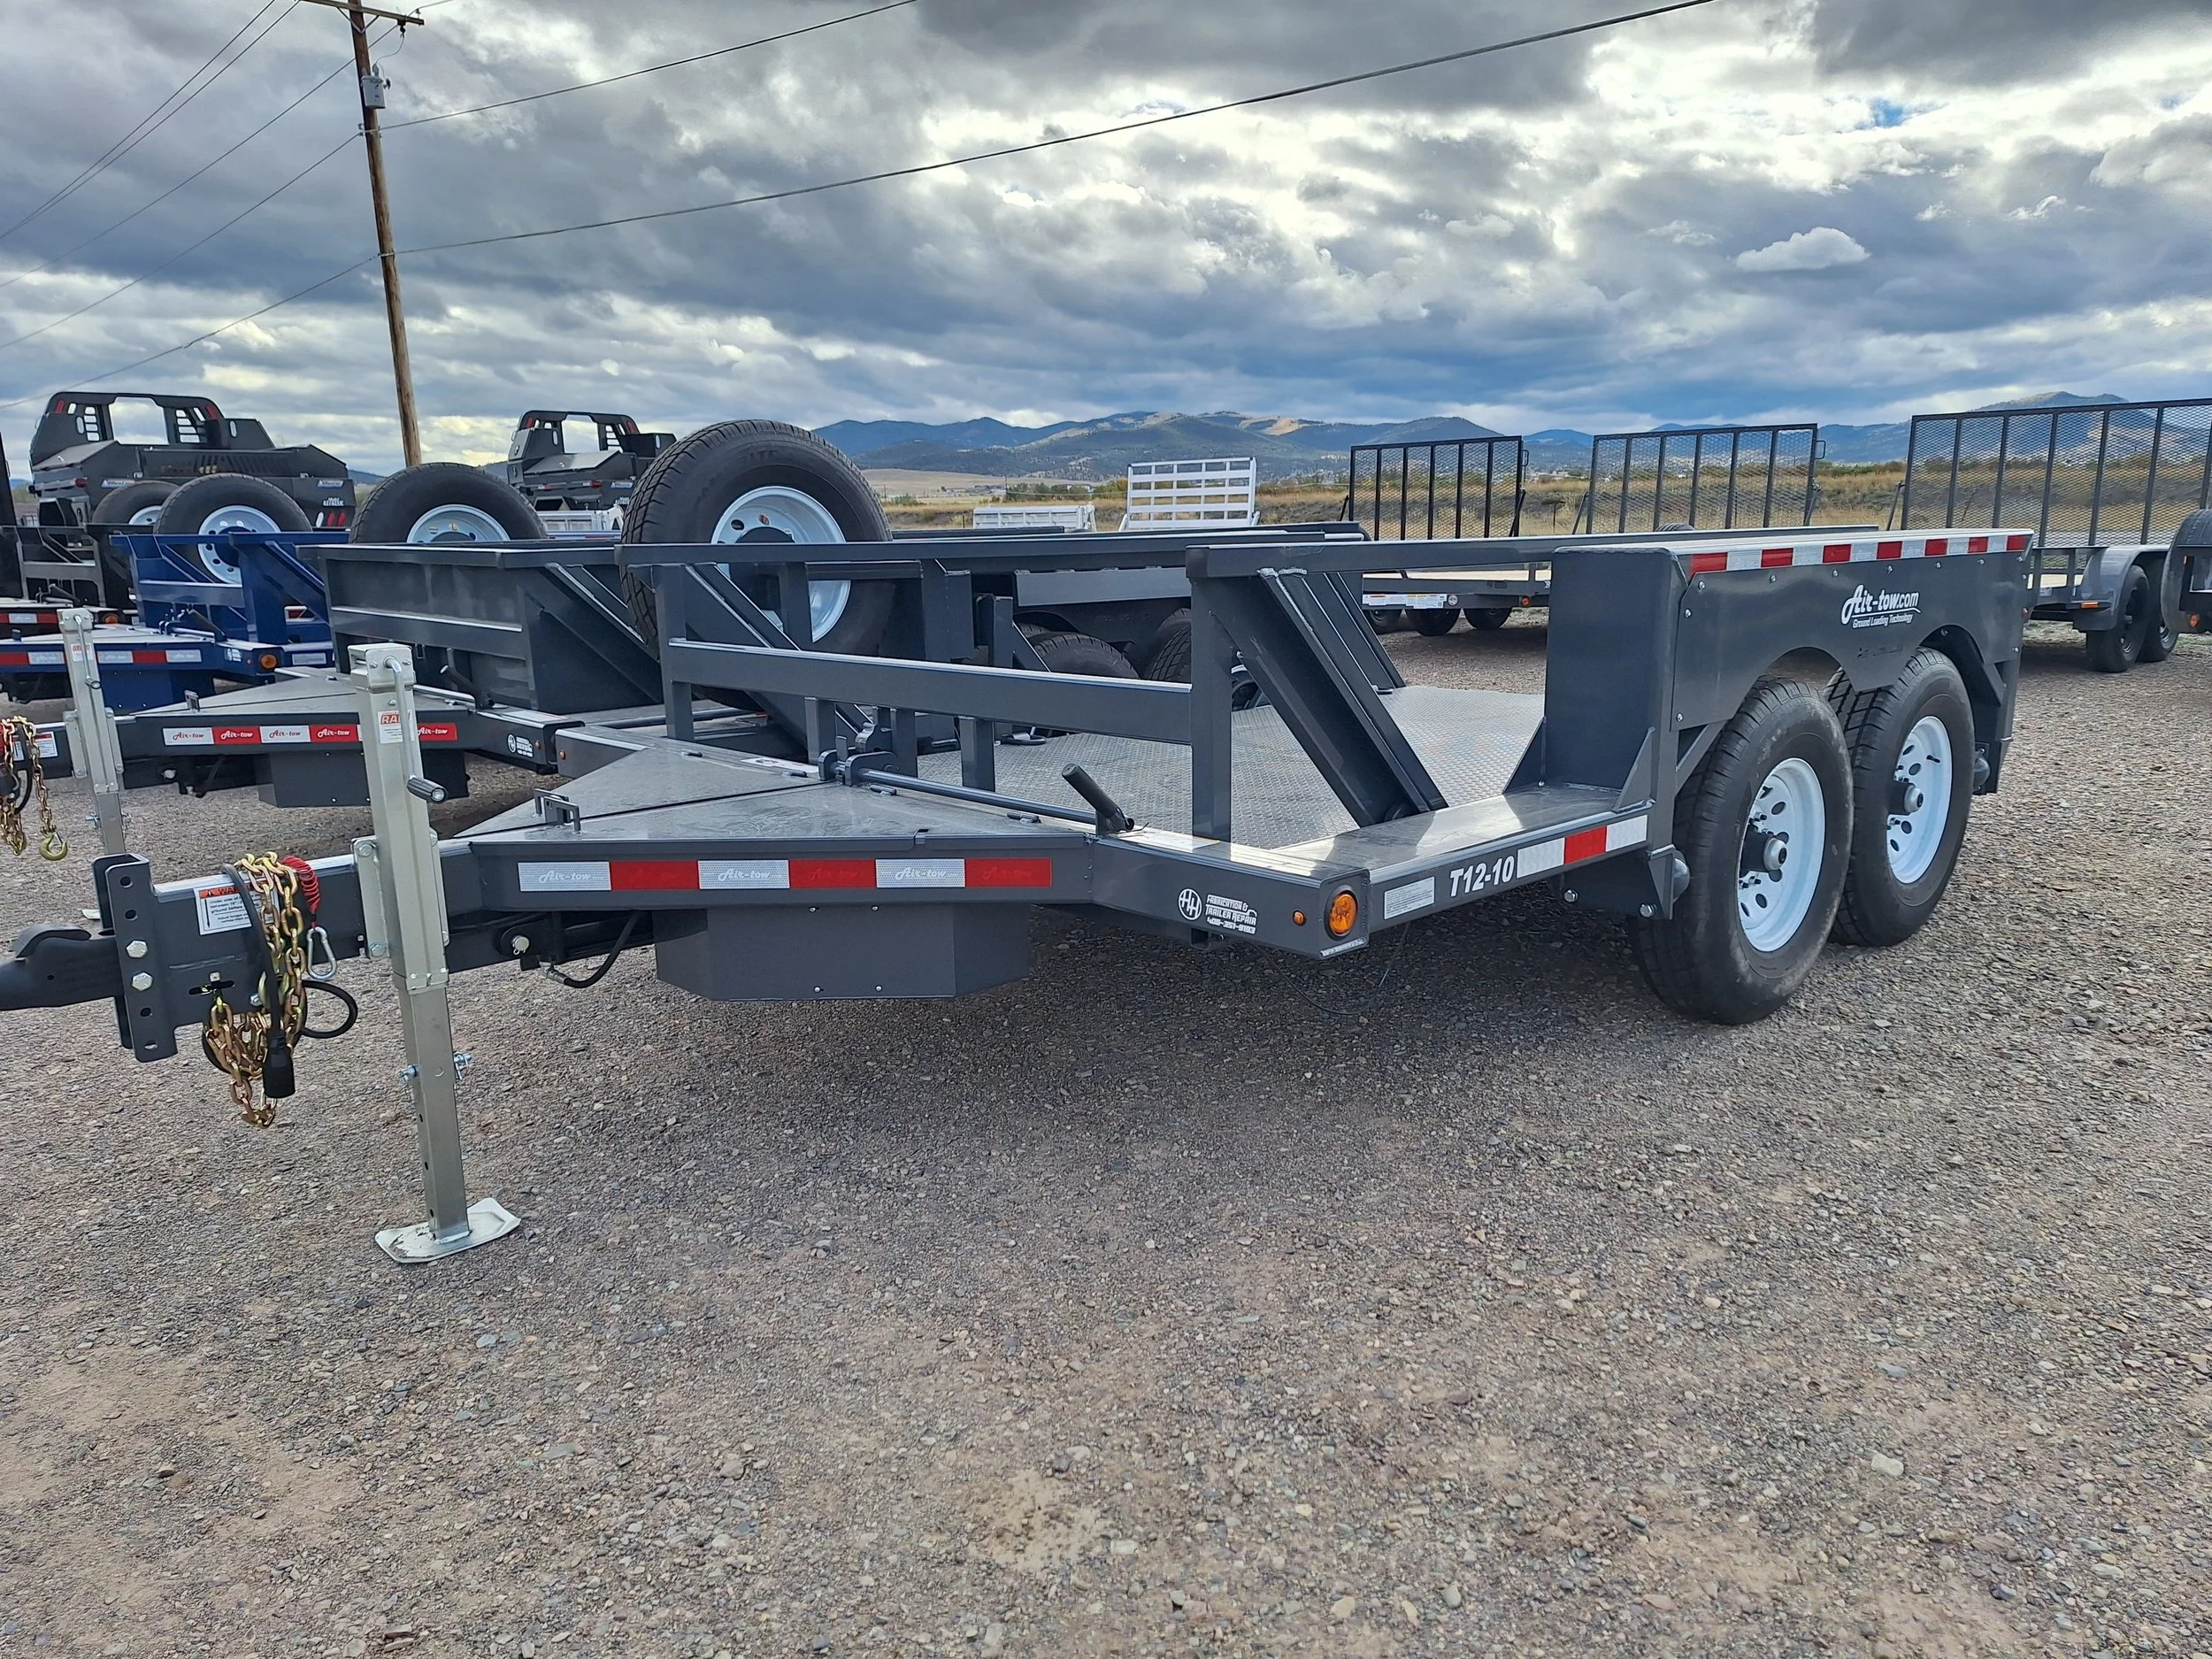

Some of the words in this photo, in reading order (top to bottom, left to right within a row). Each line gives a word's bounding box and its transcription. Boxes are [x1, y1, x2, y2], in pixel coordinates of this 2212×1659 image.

[1841, 585, 1919, 625] Air-tow.com
[1853, 618, 1871, 628] Ground
[1870, 615, 1889, 626] Loading
[1889, 613, 1914, 624] Technology
[173, 731, 204, 741] Air-tow
[220, 729, 253, 741] Air-tow
[269, 729, 302, 739] Air-tow
[317, 727, 350, 738] Air-tow
[538, 870, 592, 884] Air-tow
[718, 868, 771, 882] Air-tow
[895, 867, 947, 880] Air-tow
[1450, 856, 1516, 897] T12-10
[1205, 904, 1233, 920] TRAILER
[1232, 911, 1256, 926] REPAIR
